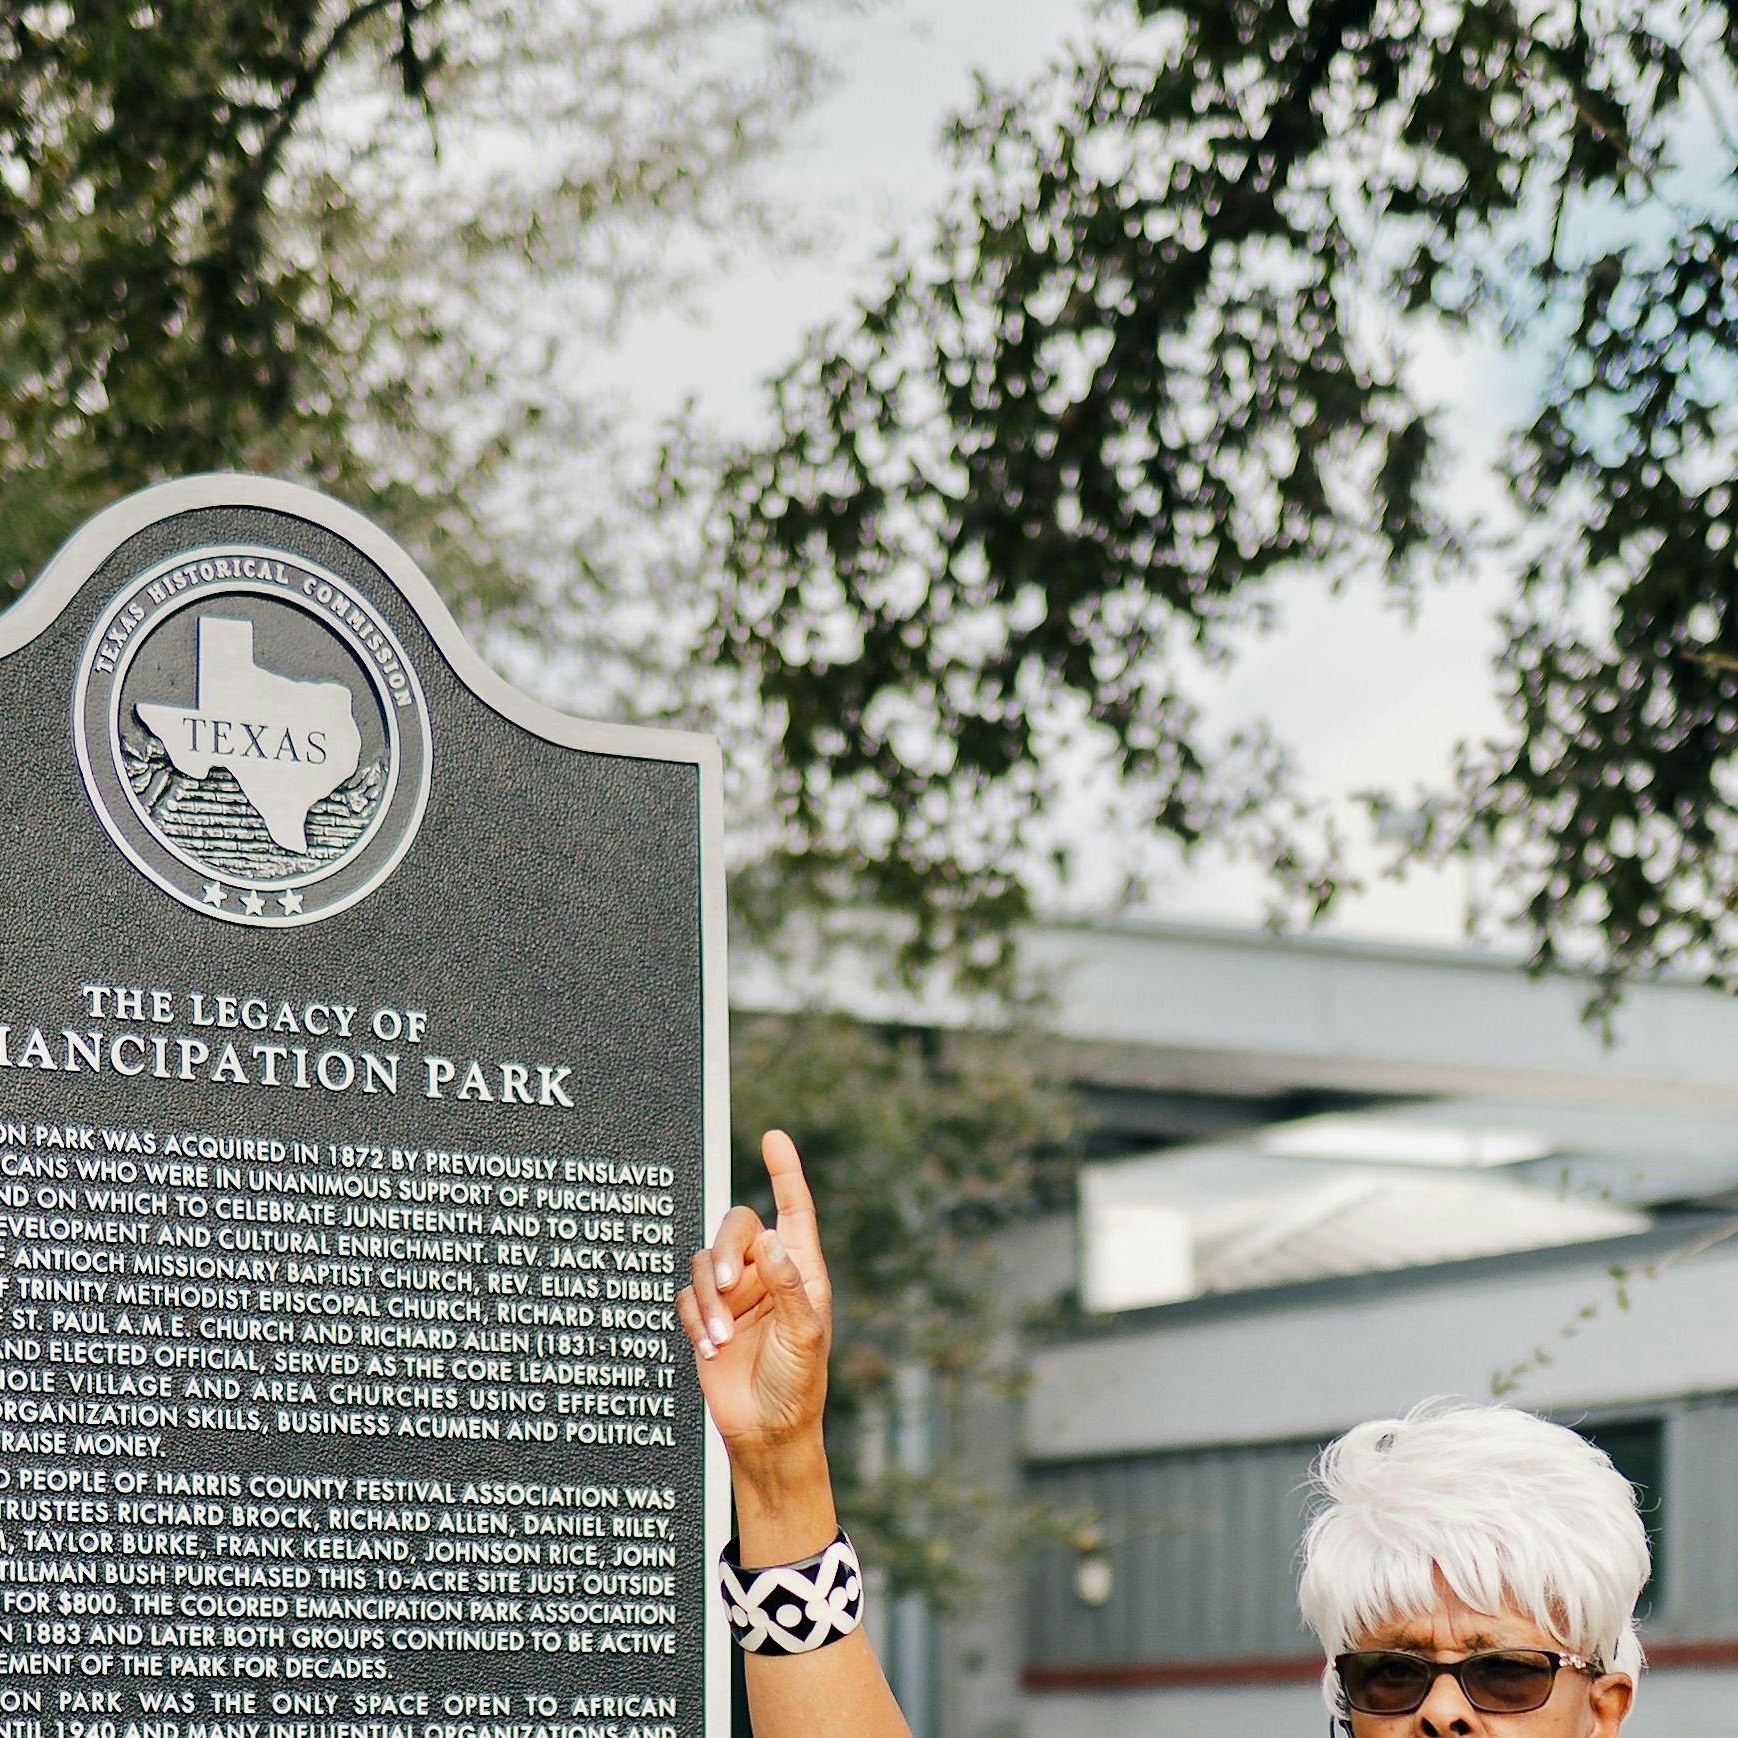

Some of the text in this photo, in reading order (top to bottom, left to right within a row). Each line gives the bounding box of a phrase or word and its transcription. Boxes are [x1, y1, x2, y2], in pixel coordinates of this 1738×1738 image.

[96, 558, 413, 708] TEXAS HISTORICAL COMMISSION
[182, 717, 328, 765] TEXAS
[83, 984, 429, 1044] THE LEGACY OF
[425, 1056, 575, 1109] PARK
[34, 1124, 95, 1151] PARK
[98, 1128, 157, 1154] WAS
[164, 1134, 286, 1162] ACQUIRED
[294, 1142, 319, 1165] IN
[329, 1144, 383, 1170] 1872
[392, 1149, 418, 1171] BY
[424, 1149, 558, 1180] PREVIOUSLY
[564, 1159, 674, 1187] ENSLAVED
[36, 1186, 77, 1211] ON
[84, 1188, 167, 1215] WHICH
[175, 1195, 208, 1218] TO
[215, 1197, 336, 1226] CELEBRATE
[342, 1205, 483, 1234] JUNETEENTH
[490, 1213, 541, 1237] AND
[546, 1215, 578, 1239] TO
[584, 1219, 625, 1242] USE
[632, 1222, 674, 1245] FOR
[13, 1246, 124, 1274] ANTIOCH
[133, 1254, 279, 1282] MISSIONARY
[287, 1261, 373, 1287] BAPTIST
[380, 1267, 480, 1296] CHURCH,
[488, 1272, 533, 1295] REV.
[541, 1274, 600, 1299] ELIAS
[606, 1279, 674, 1302] DIBBLE
[12, 1308, 43, 1331] ST.
[53, 1310, 110, 1334] PAUL
[116, 1311, 191, 1338] A.M.E.
[199, 1315, 294, 1342] CHURCH
[301, 1322, 353, 1345] AND
[361, 1323, 457, 1350] RICHARD
[463, 1330, 529, 1353] ALLEN
[537, 1332, 675, 1363] (1831-1909),
[68, 1372, 173, 1397] VILLAGE
[184, 1376, 240, 1400] AND
[252, 1380, 318, 1404] AREA
[329, 1382, 458, 1409] CHURCHES
[470, 1389, 546, 1412] USING
[558, 1392, 675, 1417] EFFECTIVE
[1, 1430, 67, 1454] RAISE
[74, 1433, 166, 1458] MONEY.
[118, 1501, 224, 1526] RICHARD
[232, 1505, 320, 1533] BROCK,
[329, 1508, 431, 1532] RICHARD
[438, 1510, 518, 1538] ALLEN,
[524, 1513, 606, 1537] DANIEL
[613, 1516, 675, 1542] RILEY,
[105, 1563, 165, 1585] BUSH
[175, 1564, 311, 1588] PURCHASED
[317, 1565, 367, 1590] THIS
[373, 1568, 470, 1592] 10-ACRE
[477, 1569, 521, 1593] SITE
[527, 1573, 578, 1594] JUST
[583, 1572, 676, 1596] OUTSIDE
[24, 1622, 81, 1645] 1883
[88, 1624, 143, 1645] AND
[151, 1624, 216, 1647] LATER
[224, 1626, 284, 1648] BOTH
[292, 1627, 385, 1650] GROUPS
[392, 1628, 524, 1651] CONTINUED
[531, 1631, 562, 1652] TO
[569, 1631, 594, 1653] BE
[600, 1632, 676, 1654] ACTIVE
[59, 1690, 122, 1713] PARK
[138, 1691, 195, 1713] WAS
[211, 1691, 256, 1714] THE
[272, 1693, 339, 1715] ONLY
[354, 1693, 429, 1715] SPACE
[444, 1694, 511, 1716] OPEN
[525, 1696, 558, 1717] TO
[572, 1697, 676, 1717] AFRICAN
